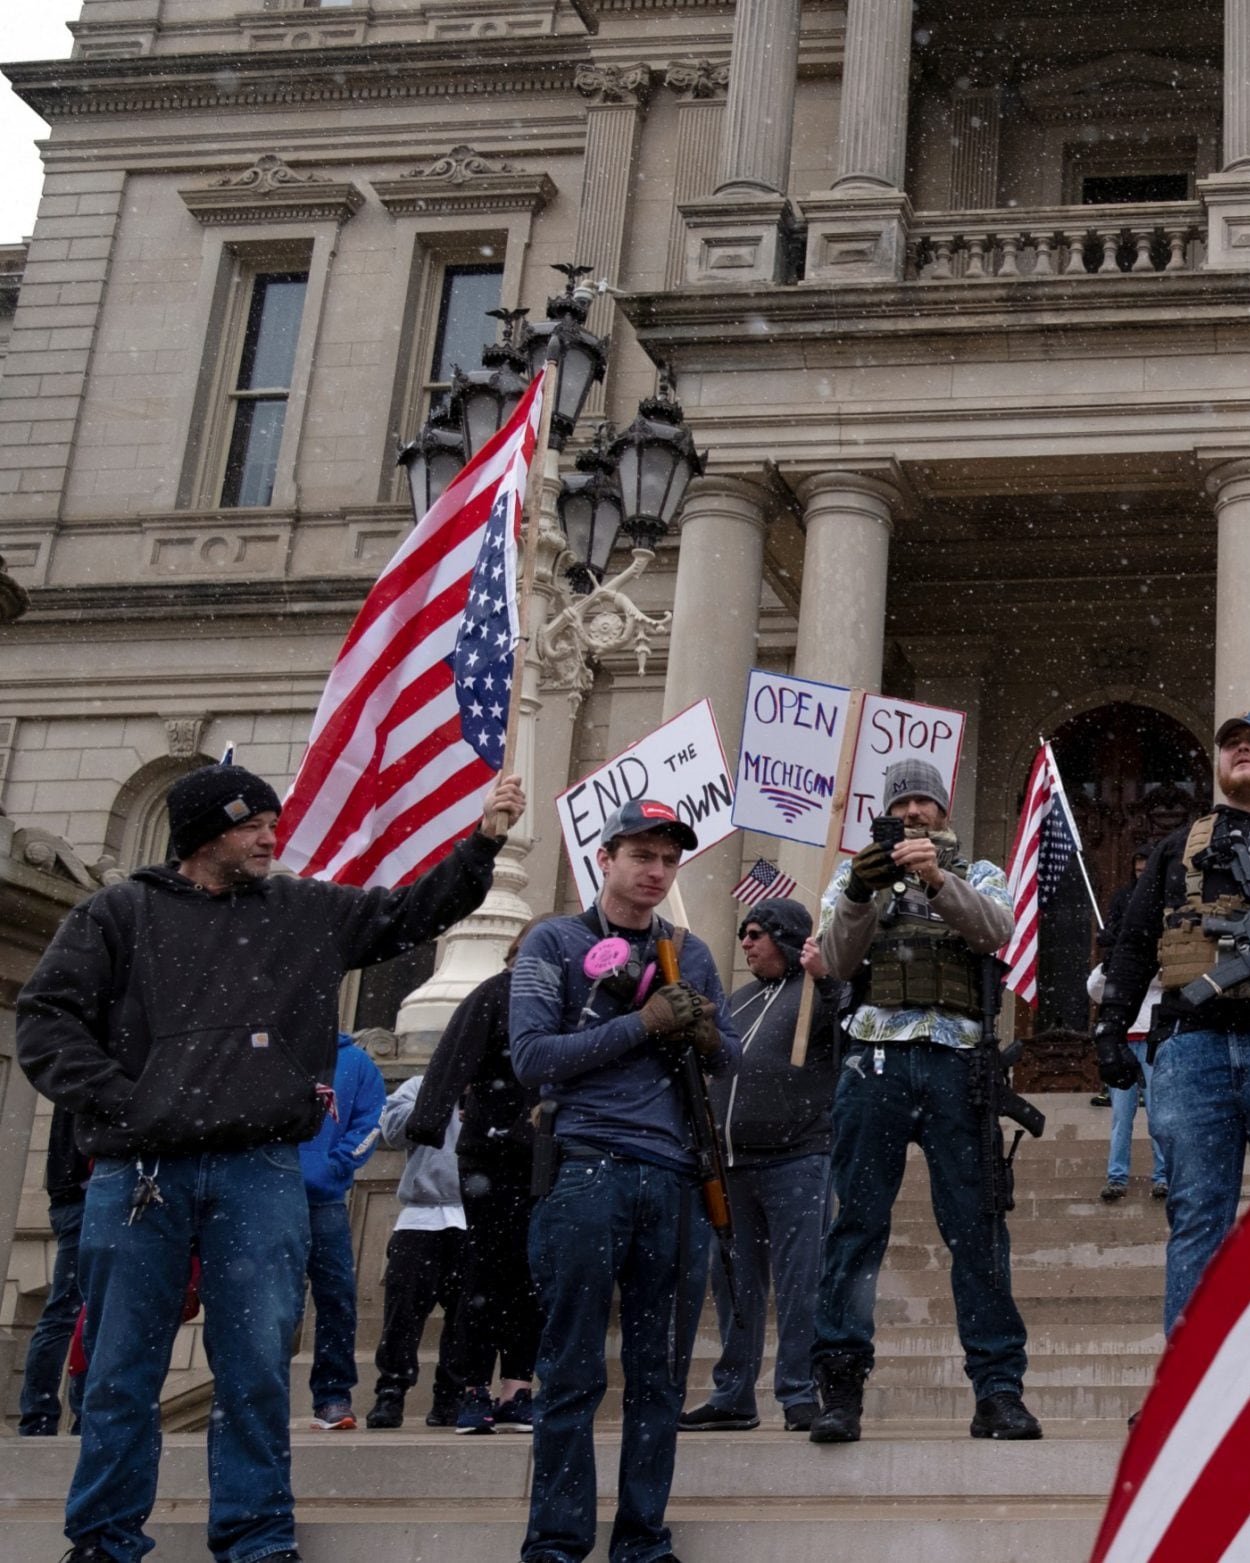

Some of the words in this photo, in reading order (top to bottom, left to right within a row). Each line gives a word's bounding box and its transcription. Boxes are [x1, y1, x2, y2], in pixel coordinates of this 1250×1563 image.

[754, 684, 838, 738] OPEN
[870, 708, 953, 754] STOP
[566, 757, 649, 848] END
[663, 743, 698, 773] THE
[744, 750, 835, 798] MICHIGAN
